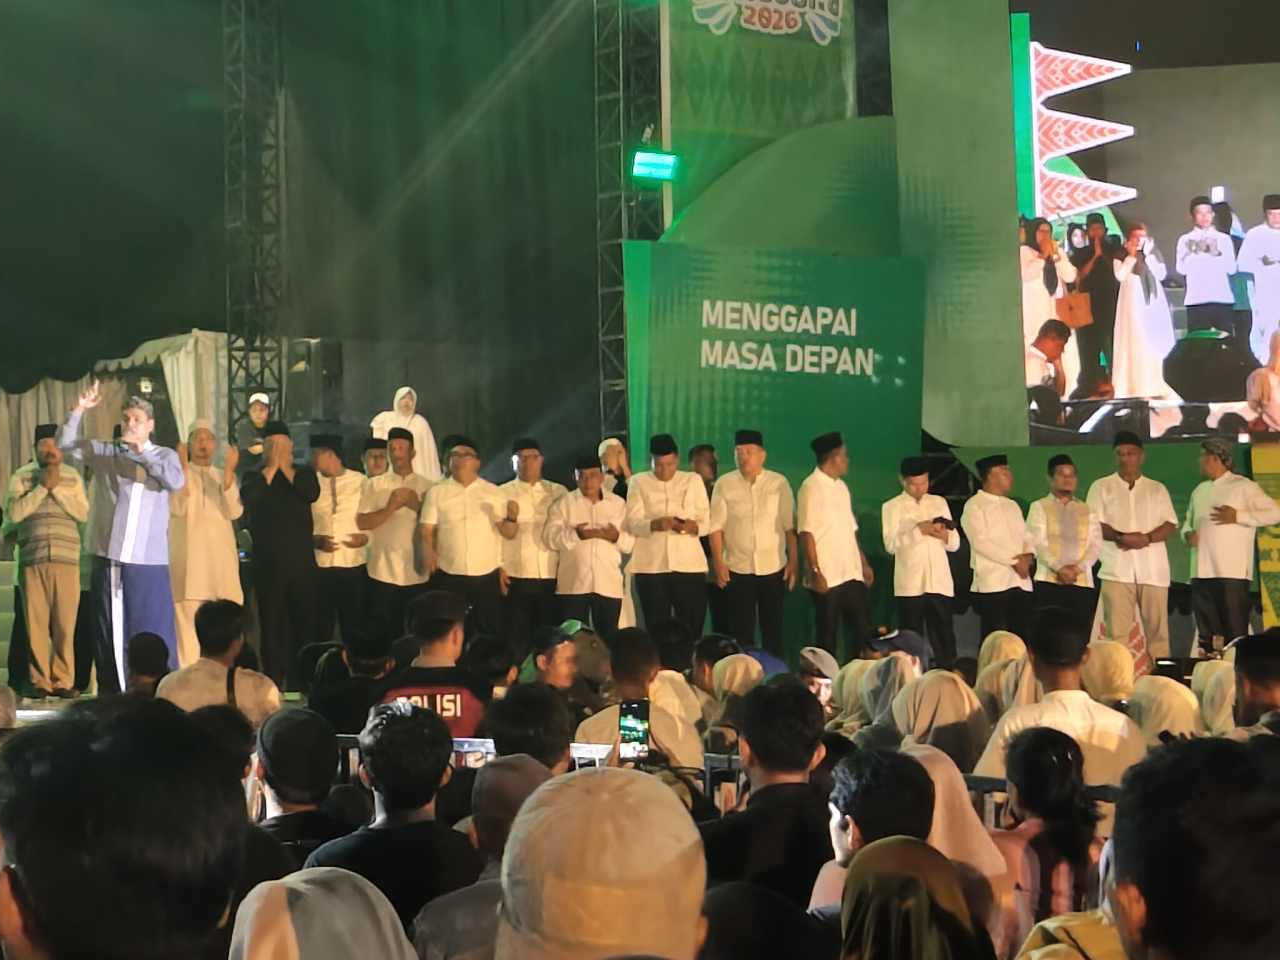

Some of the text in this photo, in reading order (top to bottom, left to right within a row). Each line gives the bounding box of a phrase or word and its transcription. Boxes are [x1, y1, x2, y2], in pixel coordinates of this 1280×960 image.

[743, 4, 799, 31] 2026
[702, 299, 857, 337] MENGGAPAI
[700, 339, 874, 376] MASA DEPAN
[396, 693, 462, 717] ISI
